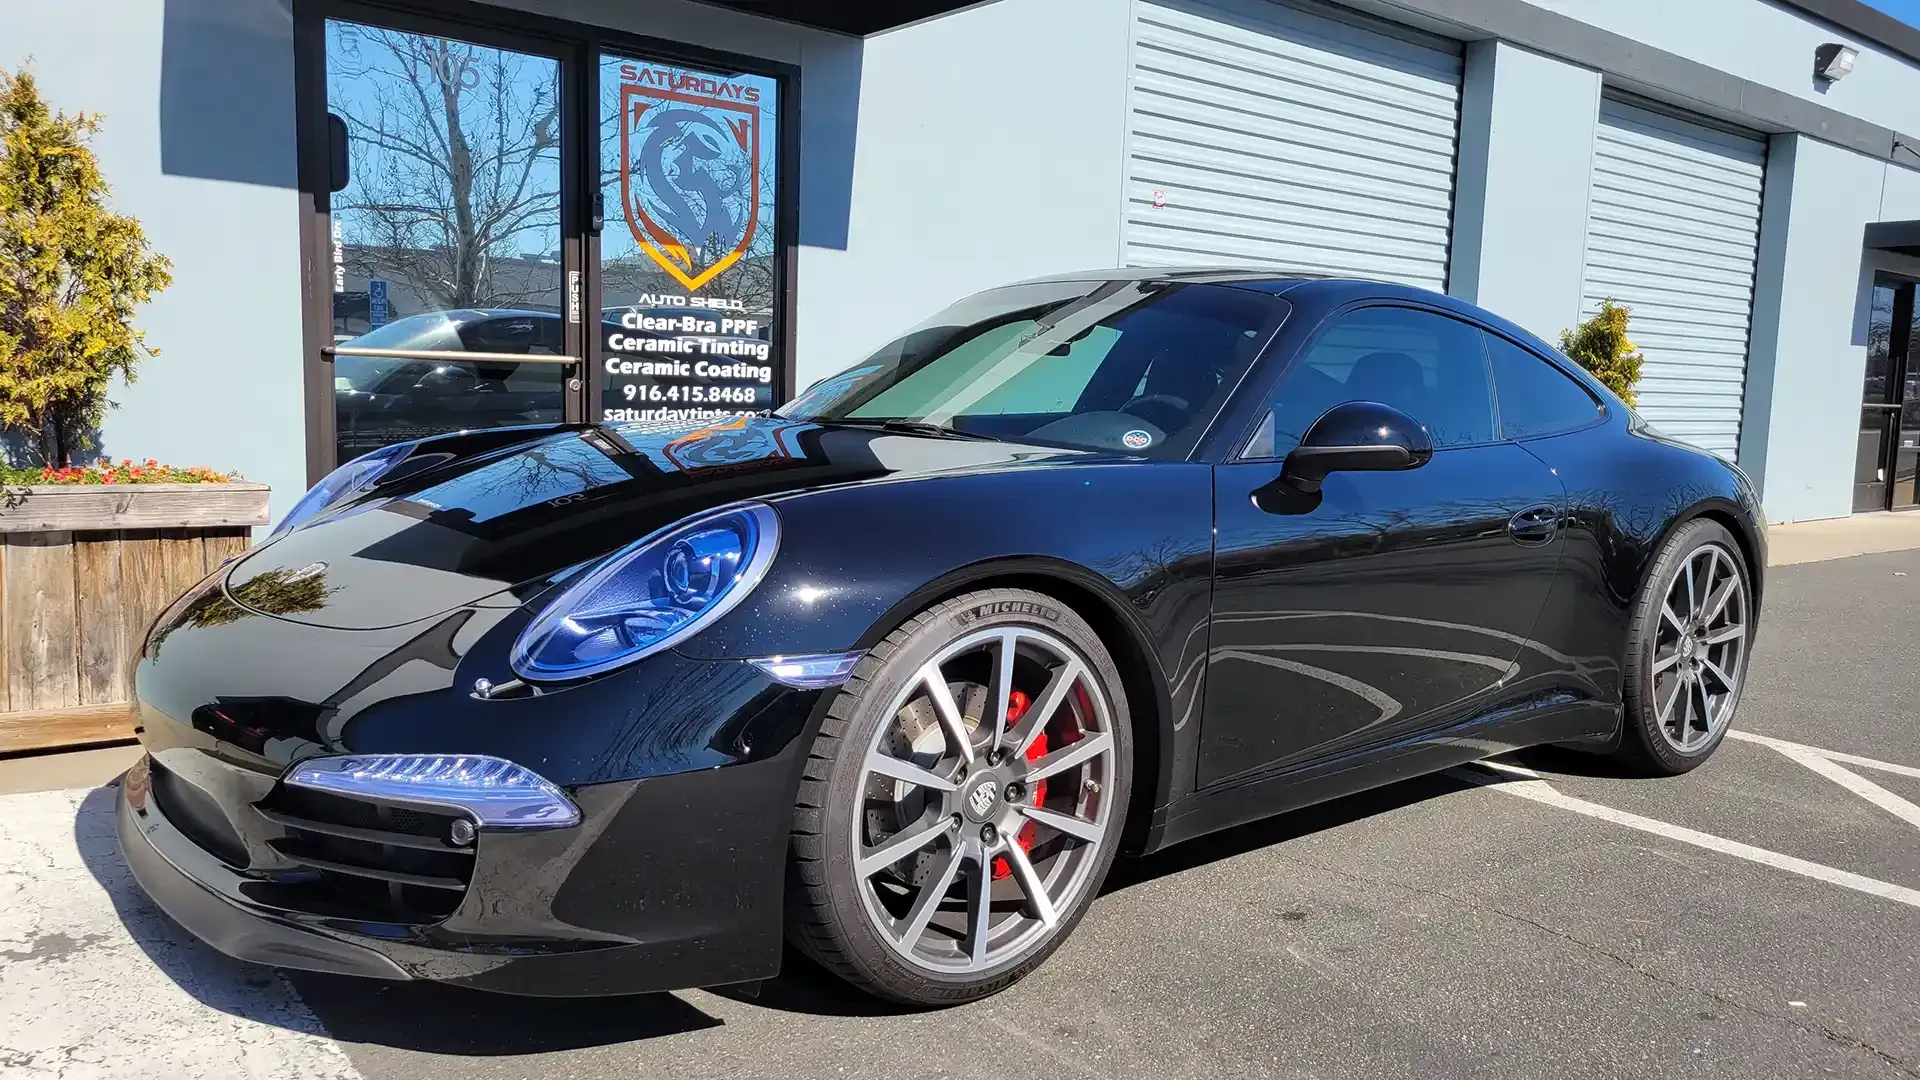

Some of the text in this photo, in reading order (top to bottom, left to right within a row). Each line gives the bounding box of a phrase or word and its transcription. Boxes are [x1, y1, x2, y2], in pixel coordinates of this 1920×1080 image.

[427, 49, 480, 89] 105
[620, 64, 760, 102] SATURDAYS
[333, 241, 344, 263] Bird
[334, 265, 346, 292] Early
[571, 275, 580, 311] PUSH
[638, 293, 743, 310] AUTO SHIELD
[622, 312, 758, 335] Clear-Bra PPF
[608, 333, 769, 361] Ceramic Tinting
[605, 357, 772, 383] Ceramic Coating
[623, 384, 756, 403] 916.415.8468
[980, 601, 1060, 620] MICHELIN
